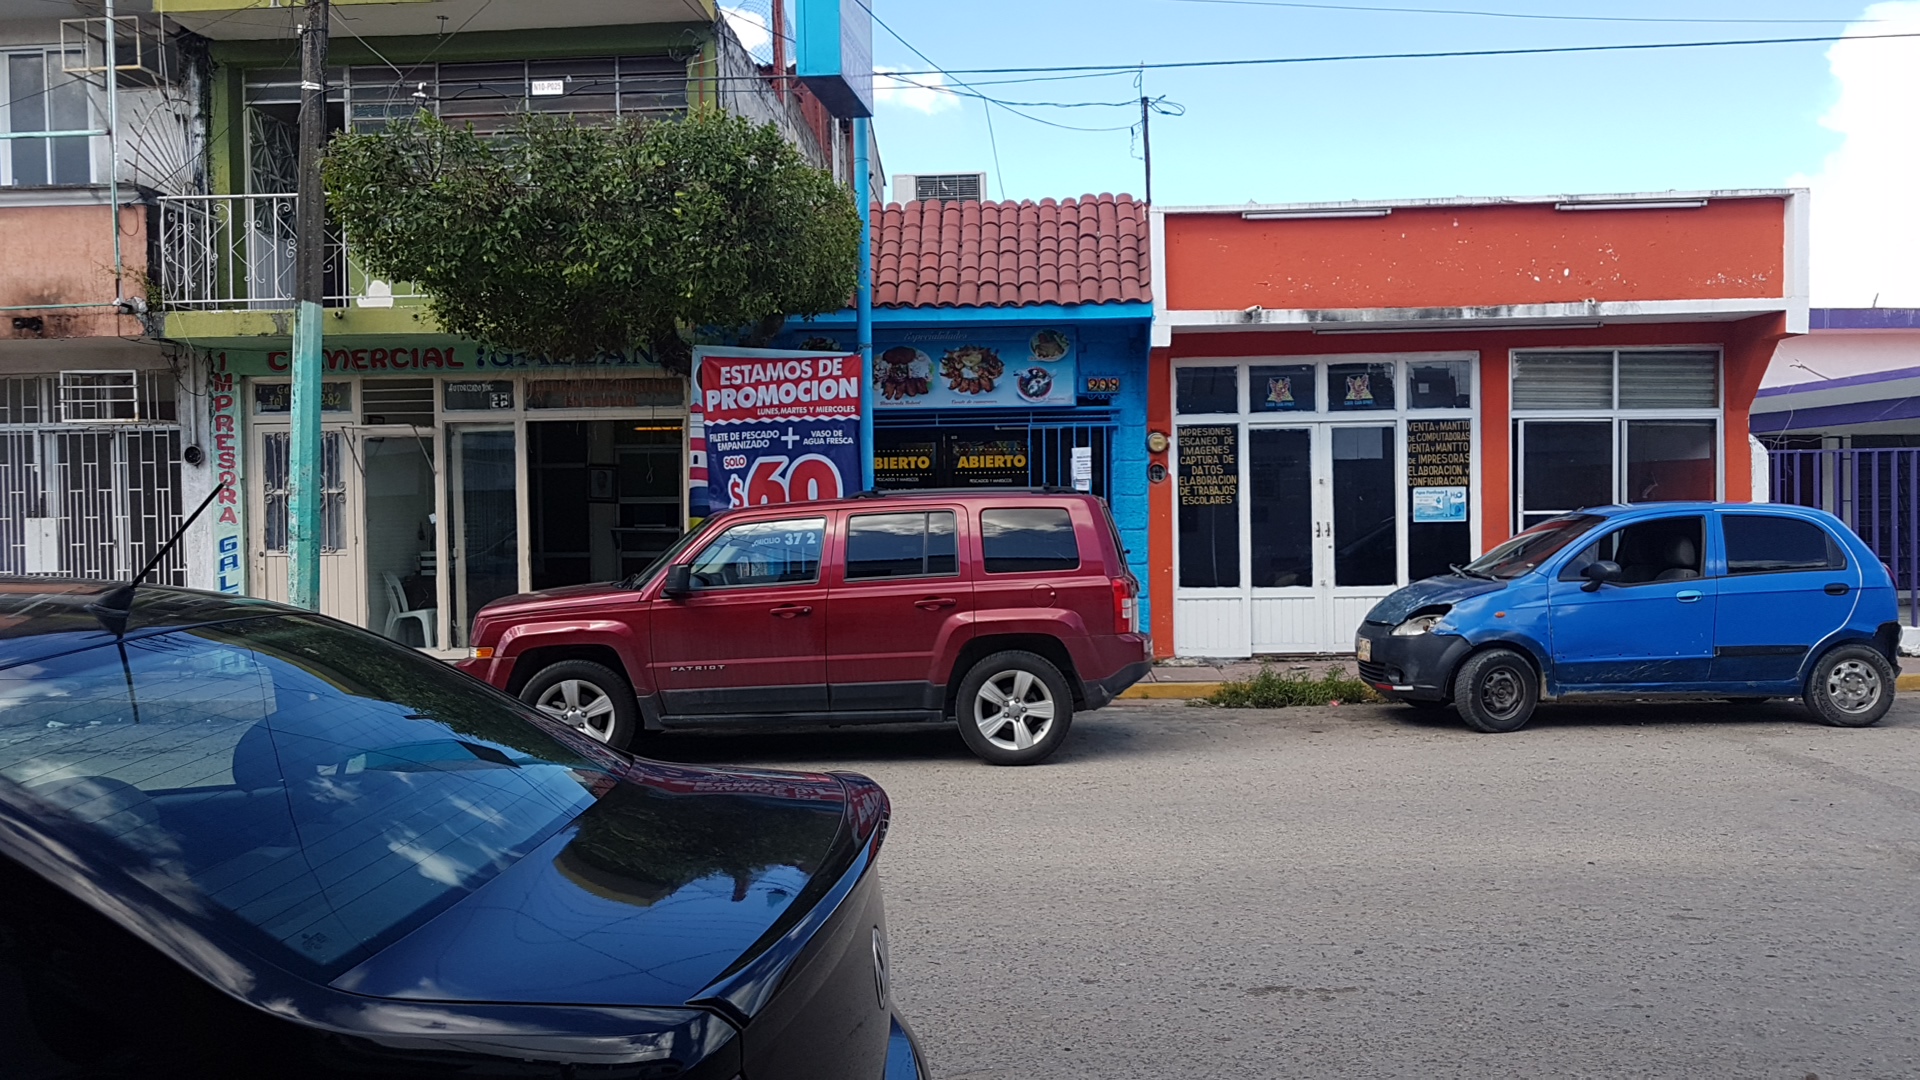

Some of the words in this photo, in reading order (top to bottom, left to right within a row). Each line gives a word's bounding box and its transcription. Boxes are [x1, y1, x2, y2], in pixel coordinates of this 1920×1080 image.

[267, 347, 464, 371] CMERCIAL
[720, 360, 813, 386] ESTAMOS
[818, 358, 843, 377] DE
[1088, 377, 1119, 392] 208
[706, 376, 859, 412] PROMOCION
[815, 405, 856, 413] MIERCOLES
[1407, 422, 1435, 432] VENTA
[1439, 420, 1470, 431] MANTTO
[709, 431, 729, 442] FILETE
[730, 431, 740, 440] DE
[741, 429, 779, 440] PESCADO
[833, 429, 843, 437] DE
[1178, 427, 1232, 437] IMPRESIONES
[1416, 431, 1470, 442] COMPUTADORAS
[717, 439, 770, 451] EMPANIZADO
[803, 437, 825, 445] AGUA
[826, 437, 854, 445] FRESCA
[1179, 436, 1218, 446] ESCANEO
[1223, 435, 1235, 445] DE
[1183, 445, 1230, 455] IMAGENES
[1407, 442, 1431, 453] VENTA
[1435, 441, 1469, 452] MANTTO
[723, 454, 747, 470] SOLO
[873, 455, 930, 470] BIERTO
[957, 454, 1027, 469] ABIERTO
[1180, 455, 1219, 465] CAPTURA
[1222, 454, 1235, 464] DE
[1418, 453, 1470, 464] IMPRESORAS
[1191, 464, 1224, 475] DATOS
[1408, 464, 1463, 476] ELABORACION
[1179, 475, 1237, 486] ELABORACION
[1408, 475, 1468, 487] CONFIGURACION
[1180, 486, 1191, 496] DE
[1192, 485, 1236, 495] TRABAJOS
[1182, 495, 1233, 505] ESCOLARES
[218, 534, 240, 595] GAL
[670, 664, 726, 672] PATRIOT
